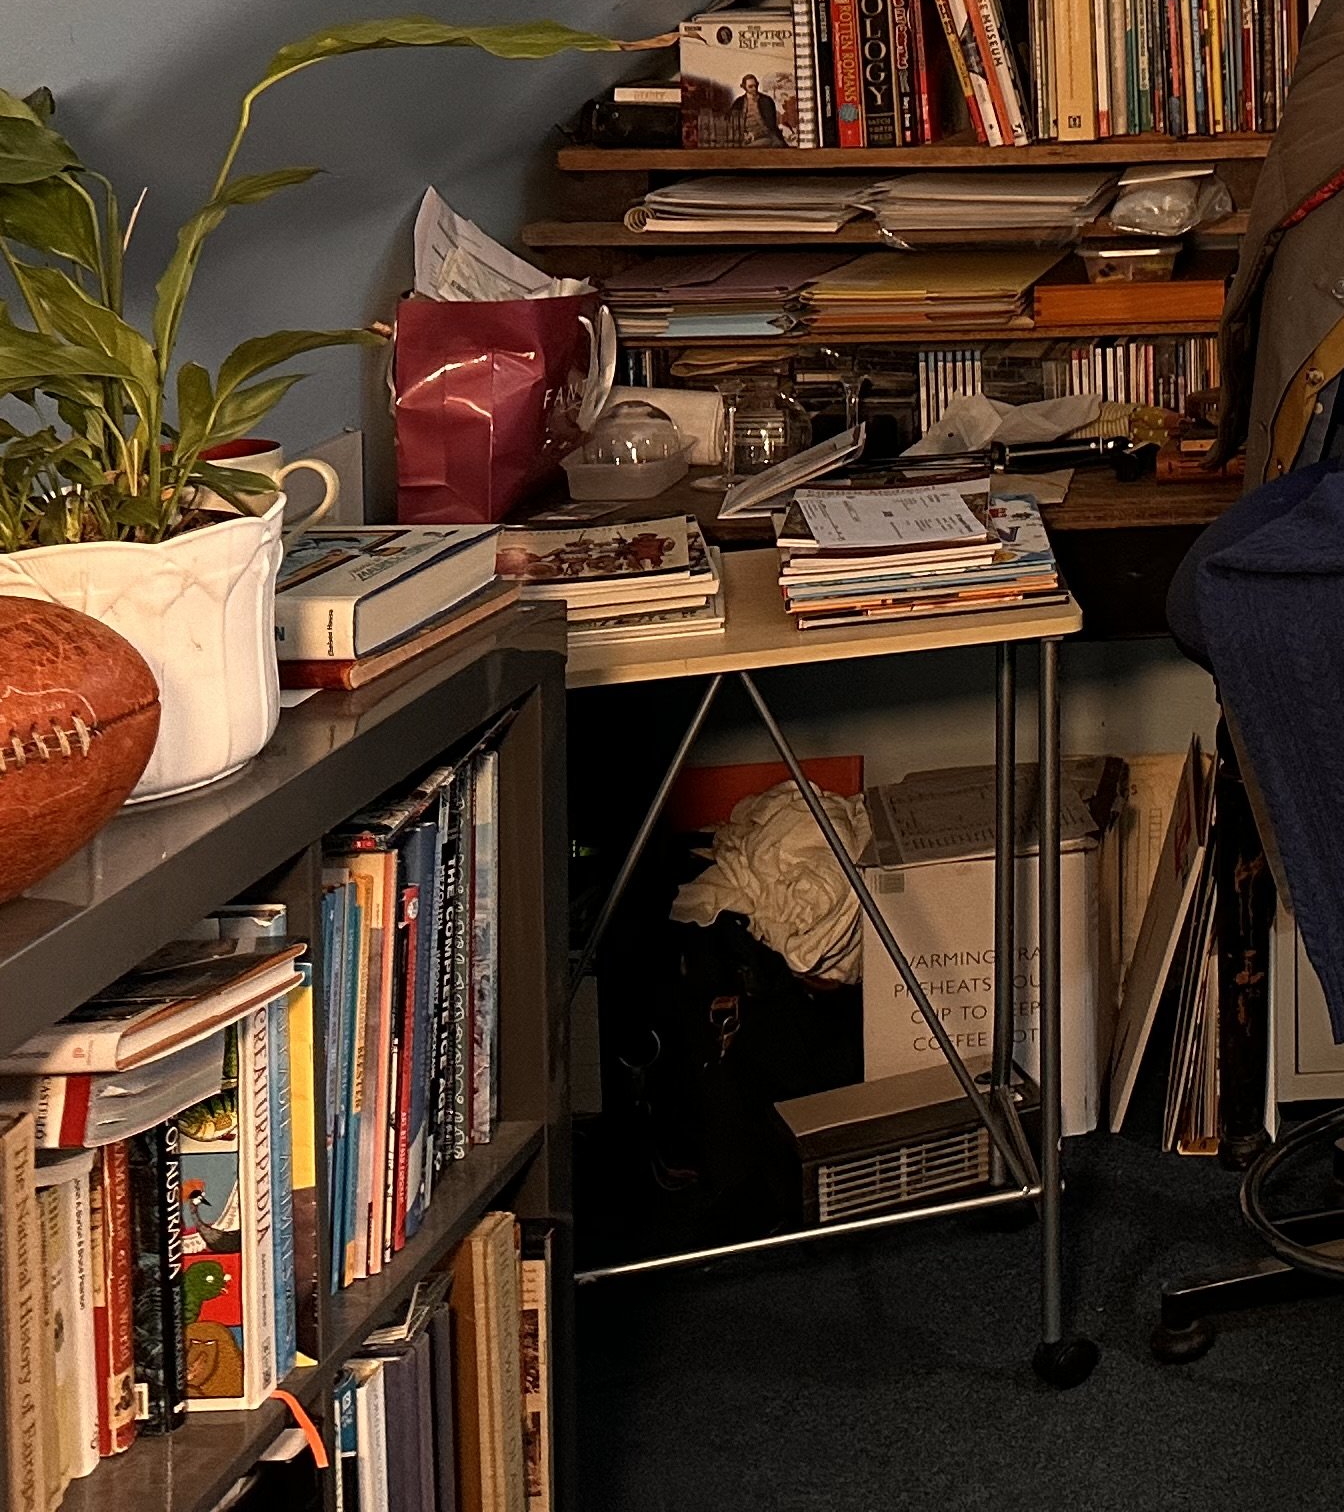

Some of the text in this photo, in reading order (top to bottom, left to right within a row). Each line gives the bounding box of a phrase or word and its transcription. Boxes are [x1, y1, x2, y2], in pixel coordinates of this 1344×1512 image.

[983, 15, 1004, 68] MUSEUM
[437, 855, 457, 1124] THE COMPLETE ICE AGE
[961, 1005, 988, 1021] TO
[913, 1028, 1039, 1051] COFEE OT
[165, 1128, 180, 1159] OF
[251, 1006, 268, 1245] CREATUREPEDIA
[14, 1145, 30, 1184] The
[16, 1194, 32, 1294] Natural
[166, 1164, 182, 1280] AUSTRALIA
[18, 1295, 35, 1388] History
[118, 1300, 132, 1367] World
